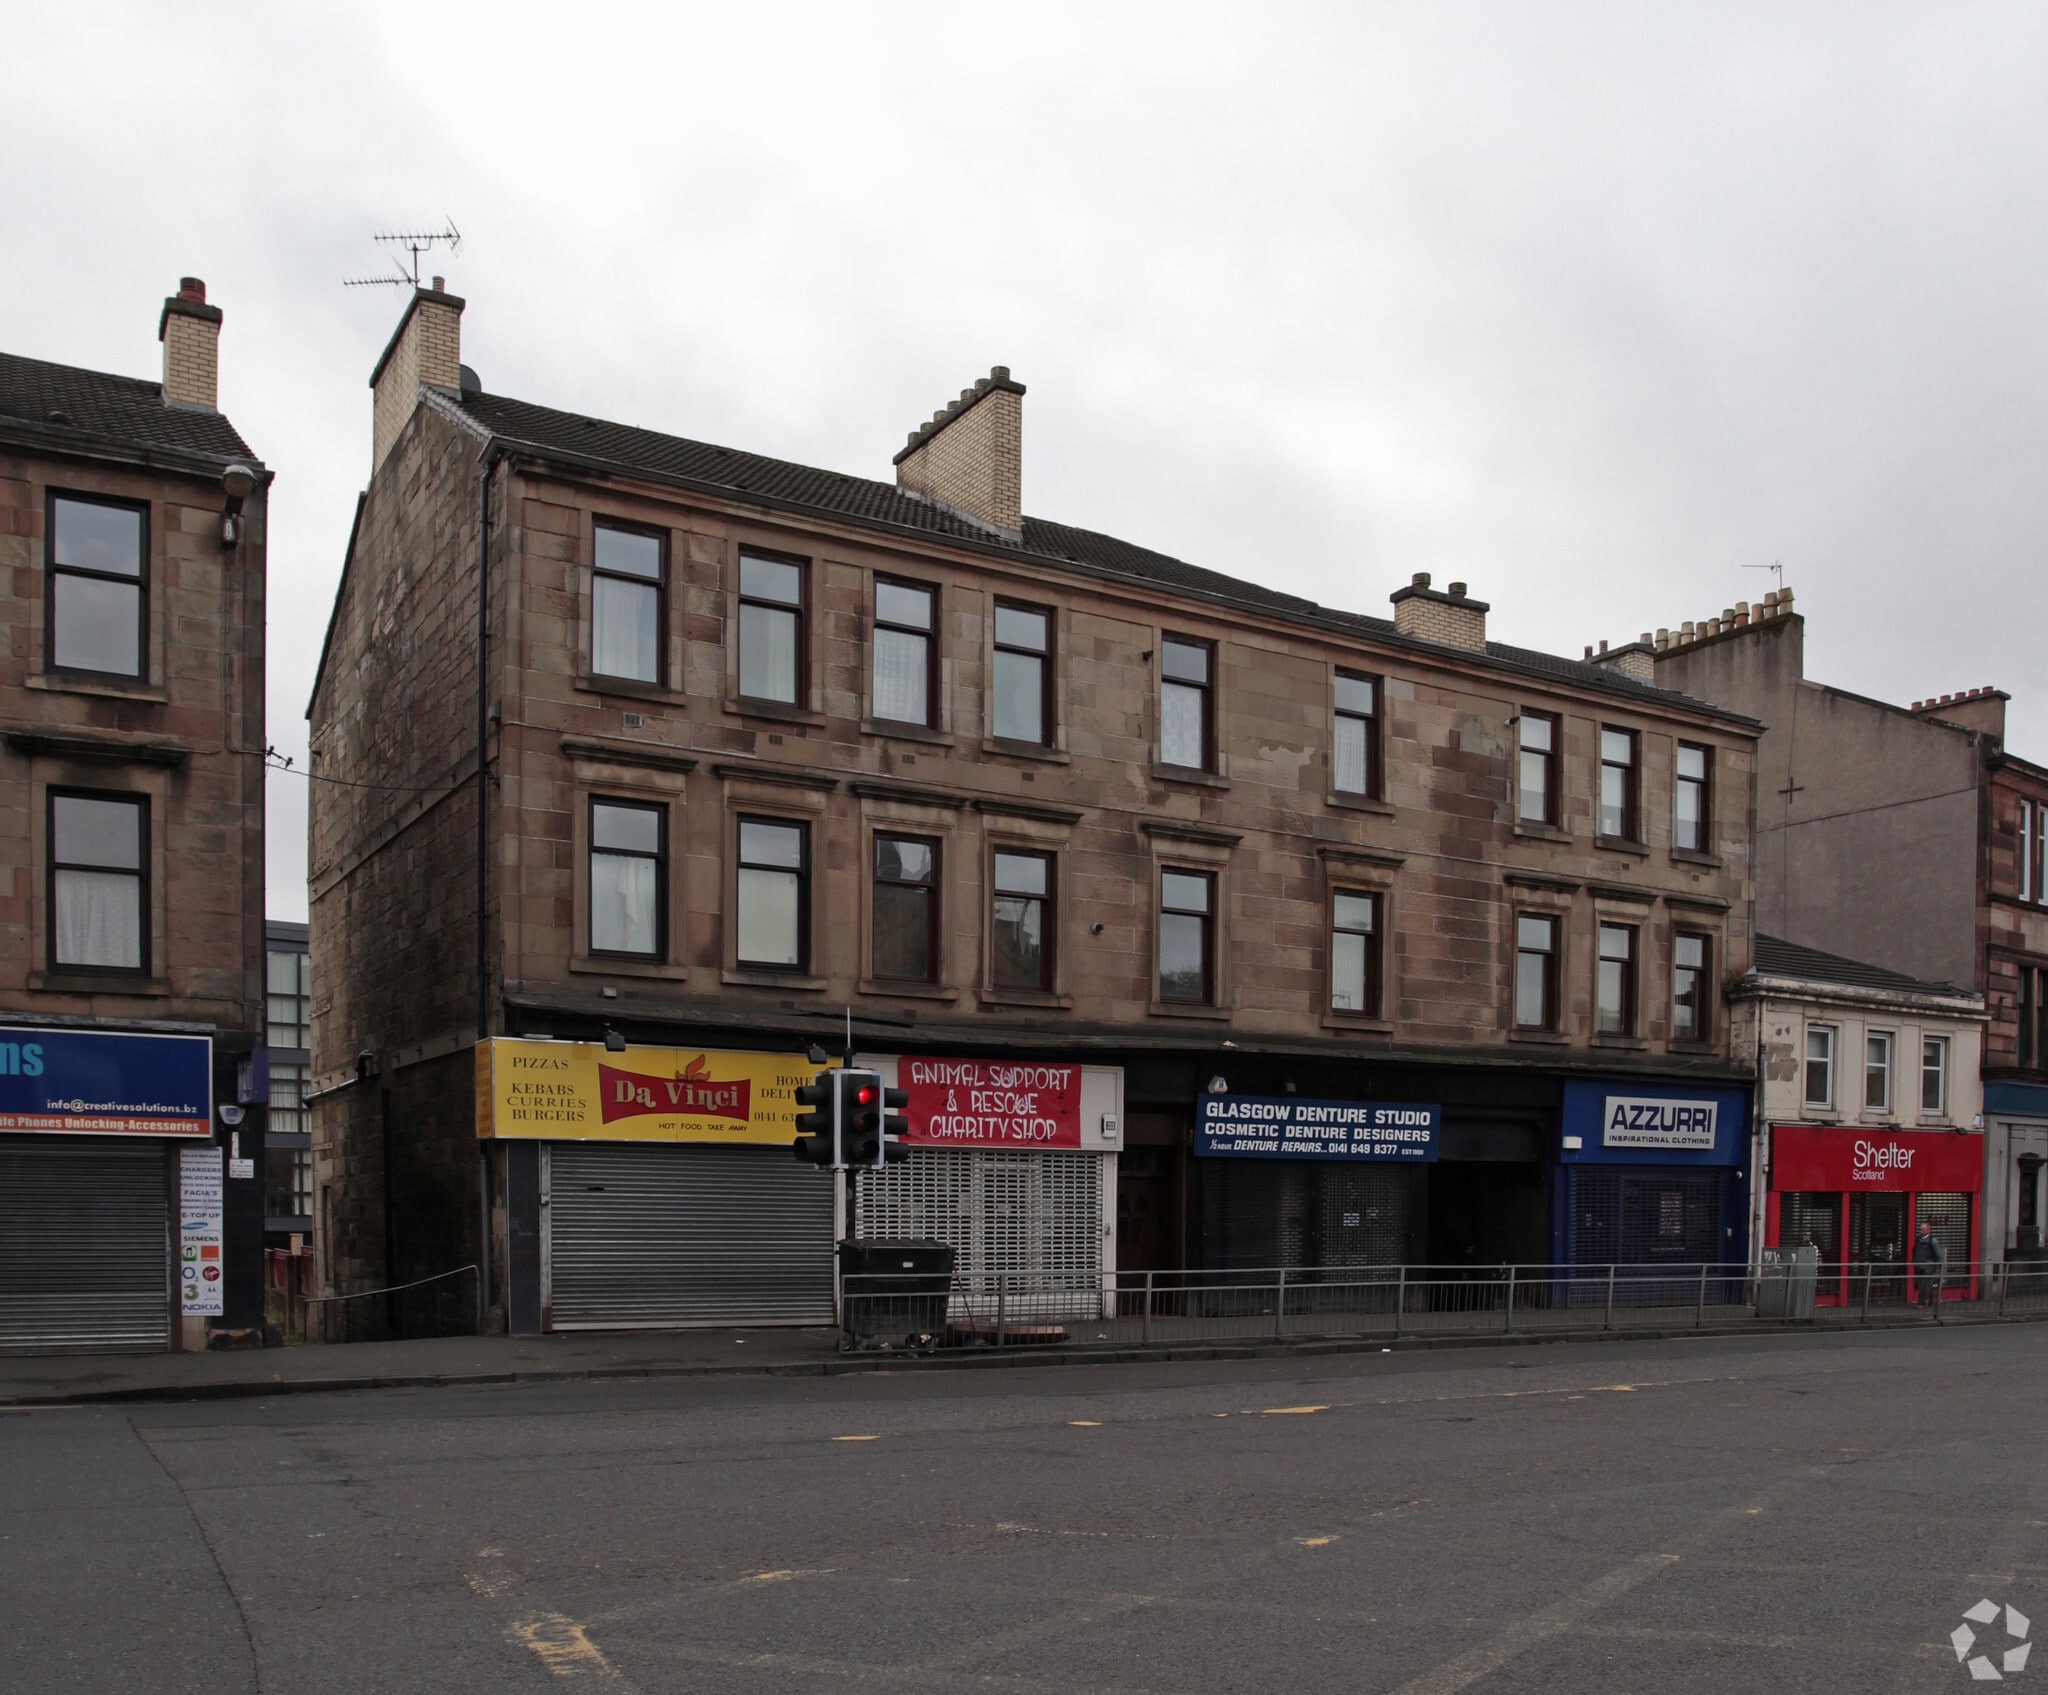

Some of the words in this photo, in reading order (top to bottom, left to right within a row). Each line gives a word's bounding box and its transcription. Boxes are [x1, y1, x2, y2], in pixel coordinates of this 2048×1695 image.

[512, 1057, 569, 1070] PIZZAS
[776, 1076, 813, 1088] HOME
[911, 1061, 985, 1087] ANIMAL
[989, 1065, 1071, 1090] SUPPORT
[511, 1082, 575, 1096] KEBABS
[614, 1080, 657, 1108] Da
[664, 1082, 739, 1111] Vinci
[761, 1088, 798, 1099] DELI
[46, 1098, 198, 1113] info@creativesolutions.bz
[506, 1096, 587, 1109] CURRIES
[946, 1089, 958, 1112] &
[971, 1090, 1039, 1115] RESCUE
[511, 1108, 585, 1122] BURGERS
[754, 1111, 776, 1122] 0141
[781, 1113, 795, 1122] 63
[1206, 1101, 1291, 1120] GLASGOW
[1295, 1106, 1368, 1123] DENTURE
[1375, 1109, 1431, 1126] STUDIO
[1610, 1104, 1713, 1133] AZZURRI
[17, 1116, 63, 1128] Phones
[64, 1118, 200, 1132] Unlocking-Accessories
[681, 1122, 703, 1131] FOOD
[707, 1123, 725, 1131] TAKE
[728, 1124, 748, 1132] AWAY
[929, 1115, 1010, 1139] CHARITY
[1011, 1118, 1057, 1140] SHOP
[1204, 1122, 1280, 1137] COSMETIC
[1285, 1125, 1348, 1139] DENTURE
[1354, 1128, 1431, 1142] DESIGNERS
[1233, 1139, 1280, 1152] DENTURE
[1328, 1143, 1348, 1153] 0141
[1350, 1143, 1371, 1154] 649
[1374, 1144, 1398, 1155] 8377
[1608, 1135, 1671, 1144] INSPIRATIONAL
[1671, 1137, 1711, 1145] CLOTHING
[1853, 1140, 1916, 1169] Shelter
[1852, 1168, 1885, 1180] Scotland
